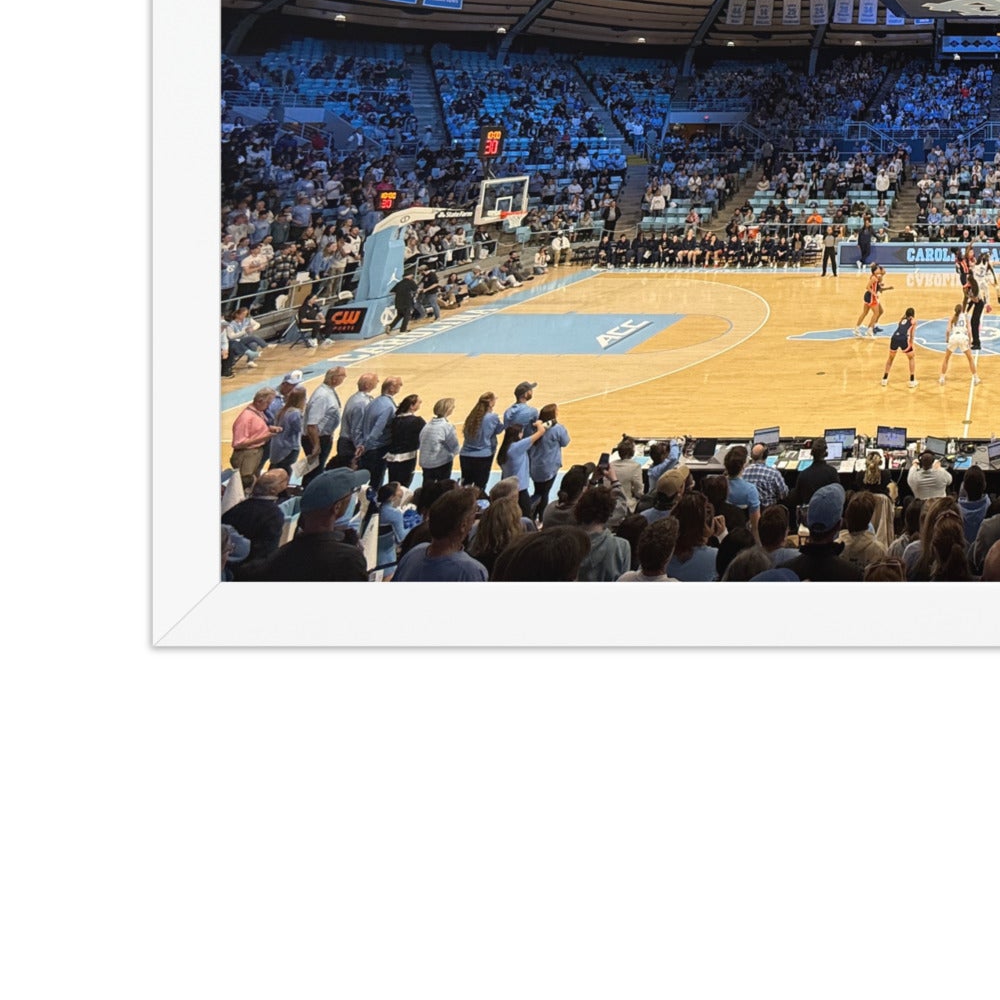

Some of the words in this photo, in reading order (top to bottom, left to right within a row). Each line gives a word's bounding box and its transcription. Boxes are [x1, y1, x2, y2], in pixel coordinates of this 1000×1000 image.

[484, 139, 499, 155] 30
[331, 311, 361, 325] CW
[596, 319, 650, 348] ACC
